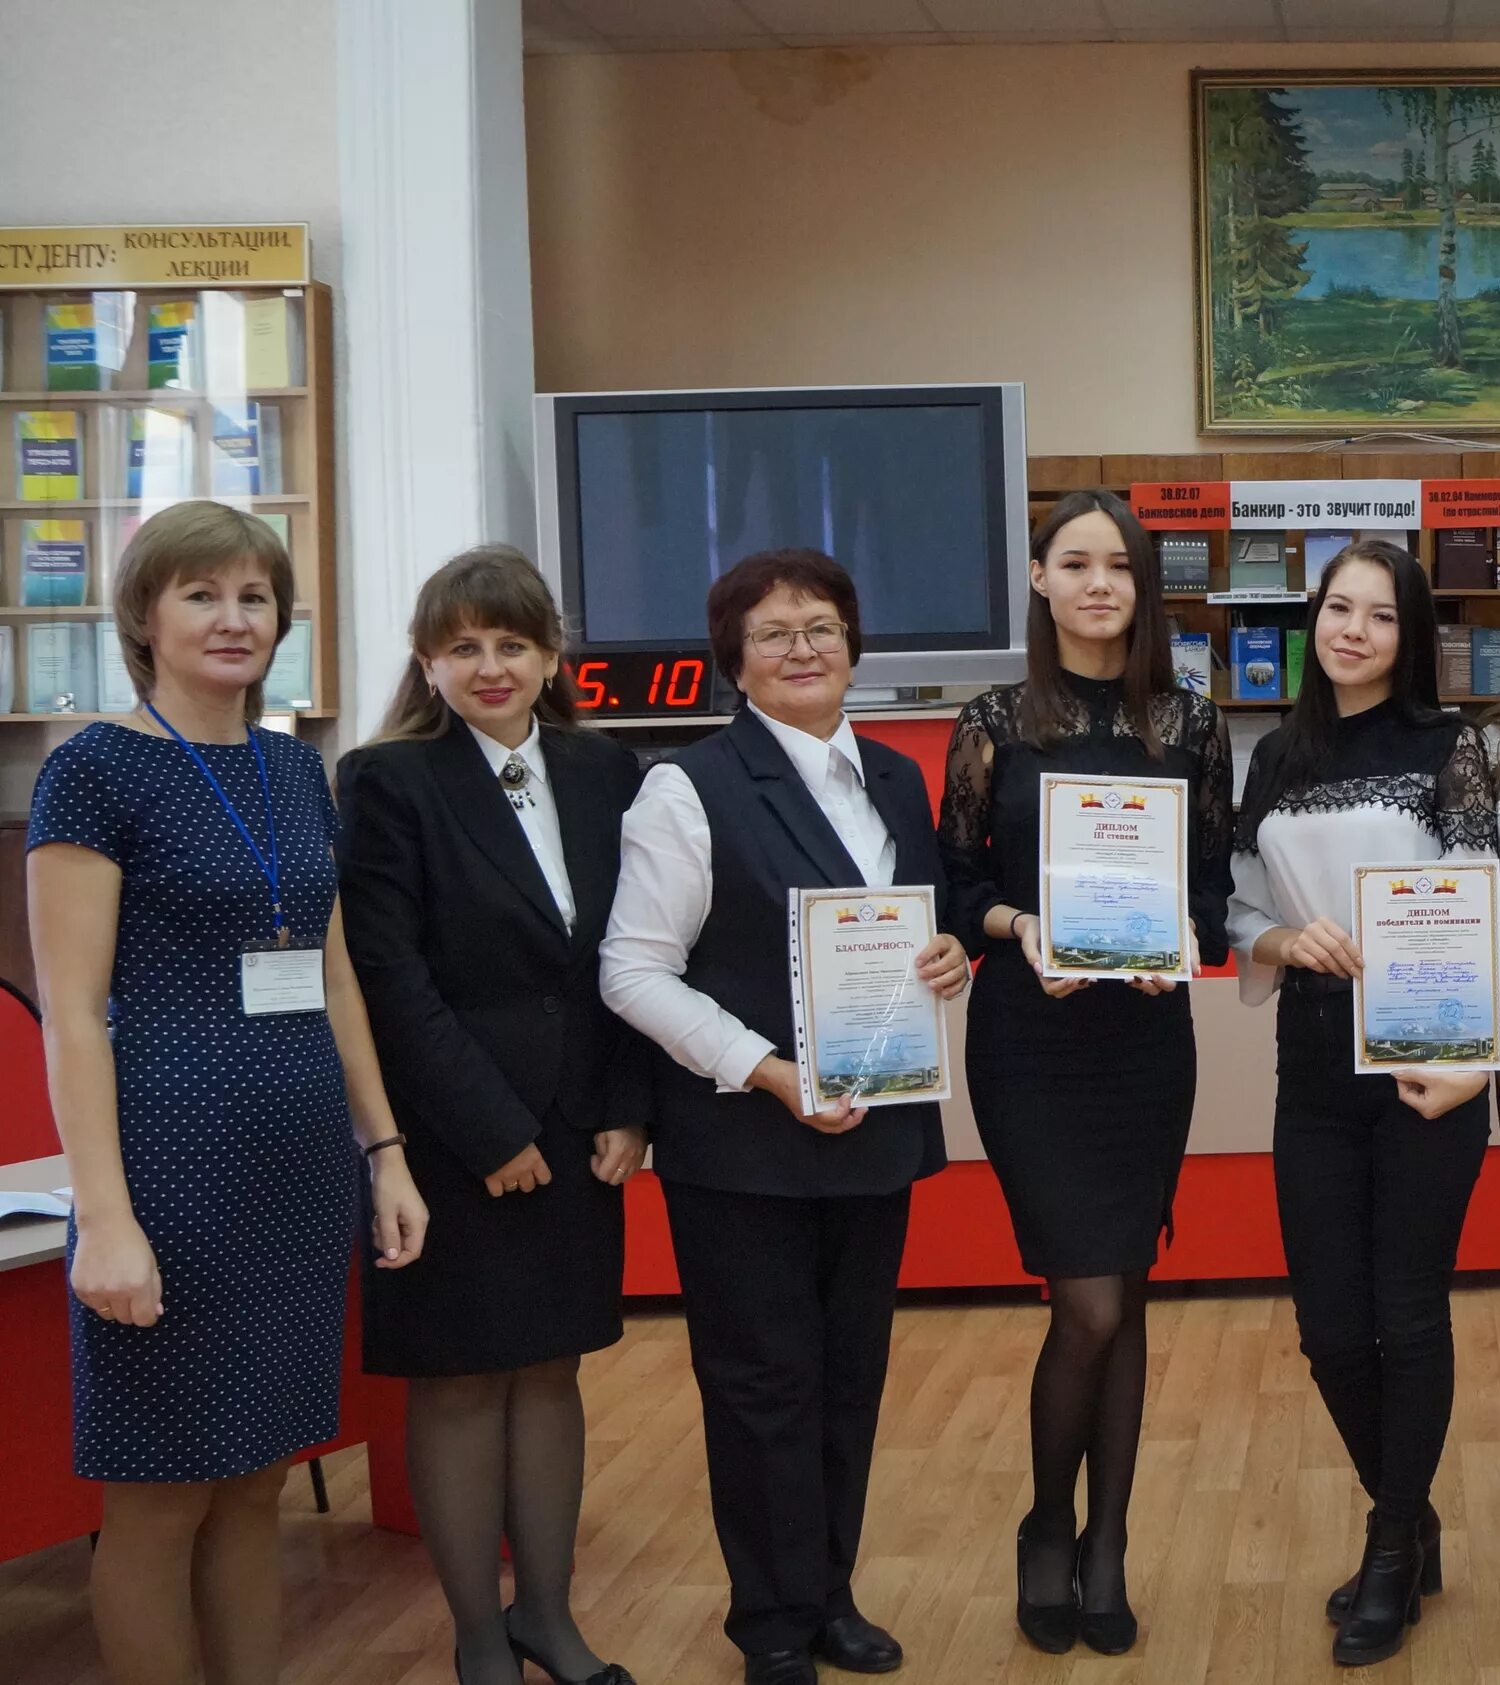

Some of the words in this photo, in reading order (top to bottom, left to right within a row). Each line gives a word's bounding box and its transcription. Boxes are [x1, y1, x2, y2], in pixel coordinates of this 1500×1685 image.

[166, 260, 250, 280] ЛЕКЦИИ
[1160, 487, 1200, 501] 38.02.07
[1138, 507, 1198, 519] Банковское
[1200, 507, 1225, 519] дело
[1232, 501, 1285, 519] Банкир
[1296, 503, 1320, 518] это
[1326, 502, 1371, 518] звучит
[1374, 500, 1416, 518] гордо!
[1095, 823, 1138, 832] ДИПЛОМ
[1107, 833, 1139, 841] степени
[1406, 908, 1450, 918] ДИПЛОМ
[1376, 918, 1424, 927] победителя
[1433, 918, 1481, 926] номинации
[835, 941, 914, 953] БЛАГОДАРНОСТЬ
